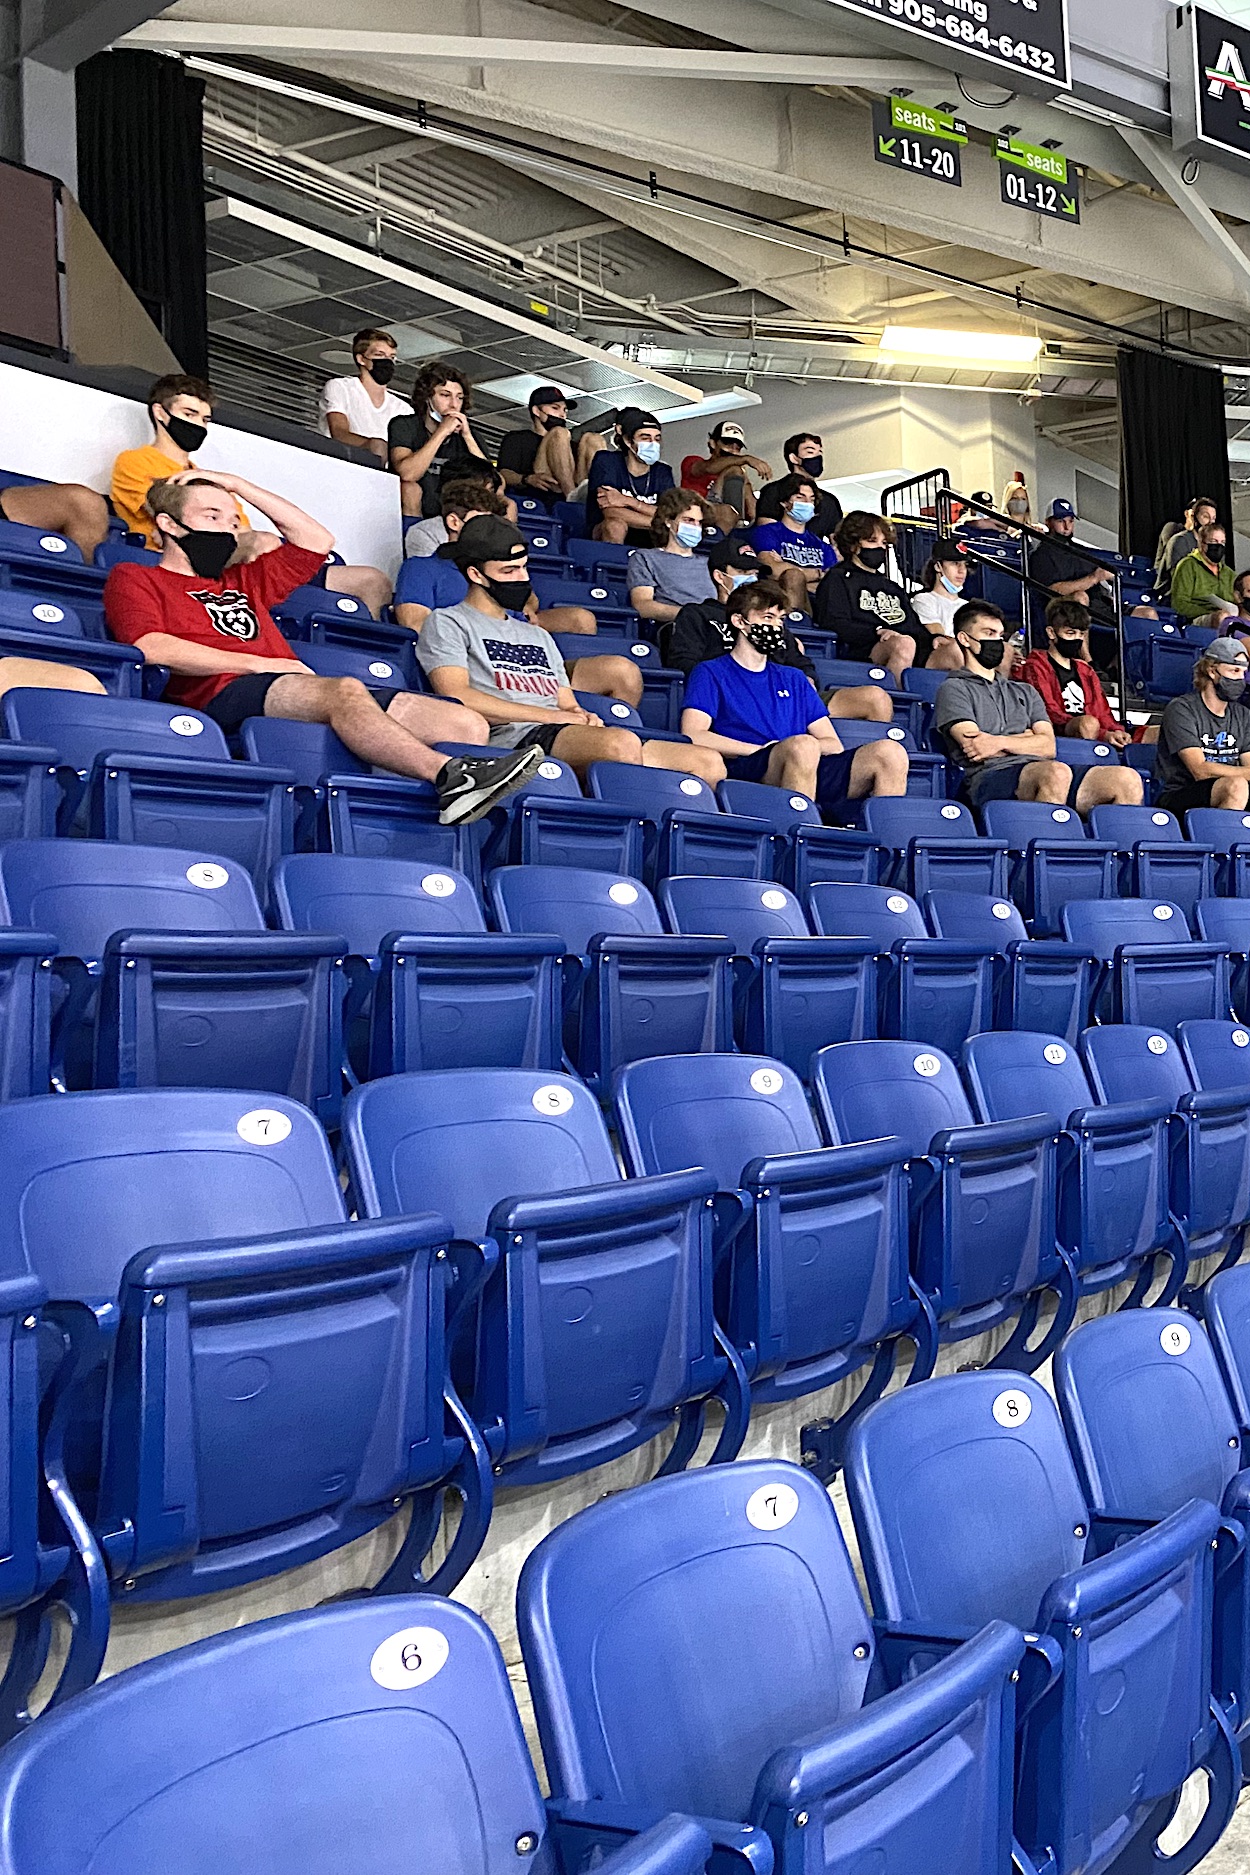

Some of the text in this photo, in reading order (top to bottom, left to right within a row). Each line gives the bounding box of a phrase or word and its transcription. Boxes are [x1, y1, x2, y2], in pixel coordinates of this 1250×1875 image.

[888, 0, 1056, 74] 905-684-6432
[894, 106, 936, 133] seats
[900, 139, 955, 179] 11-20
[1026, 152, 1063, 176] seats
[1006, 173, 1058, 213] 01-12
[42, 608, 57, 618] 10
[182, 720, 192, 731] 9
[203, 869, 214, 882] 8
[435, 879, 444, 891] 9
[920, 1059, 934, 1071] 10
[762, 1075, 772, 1088] 9
[548, 1093, 560, 1108] 8
[257, 1118, 271, 1136] 7
[1170, 1332, 1181, 1347] 9
[1006, 1399, 1019, 1418] 8
[764, 1495, 778, 1517] 7
[401, 1644, 422, 1671] 6
